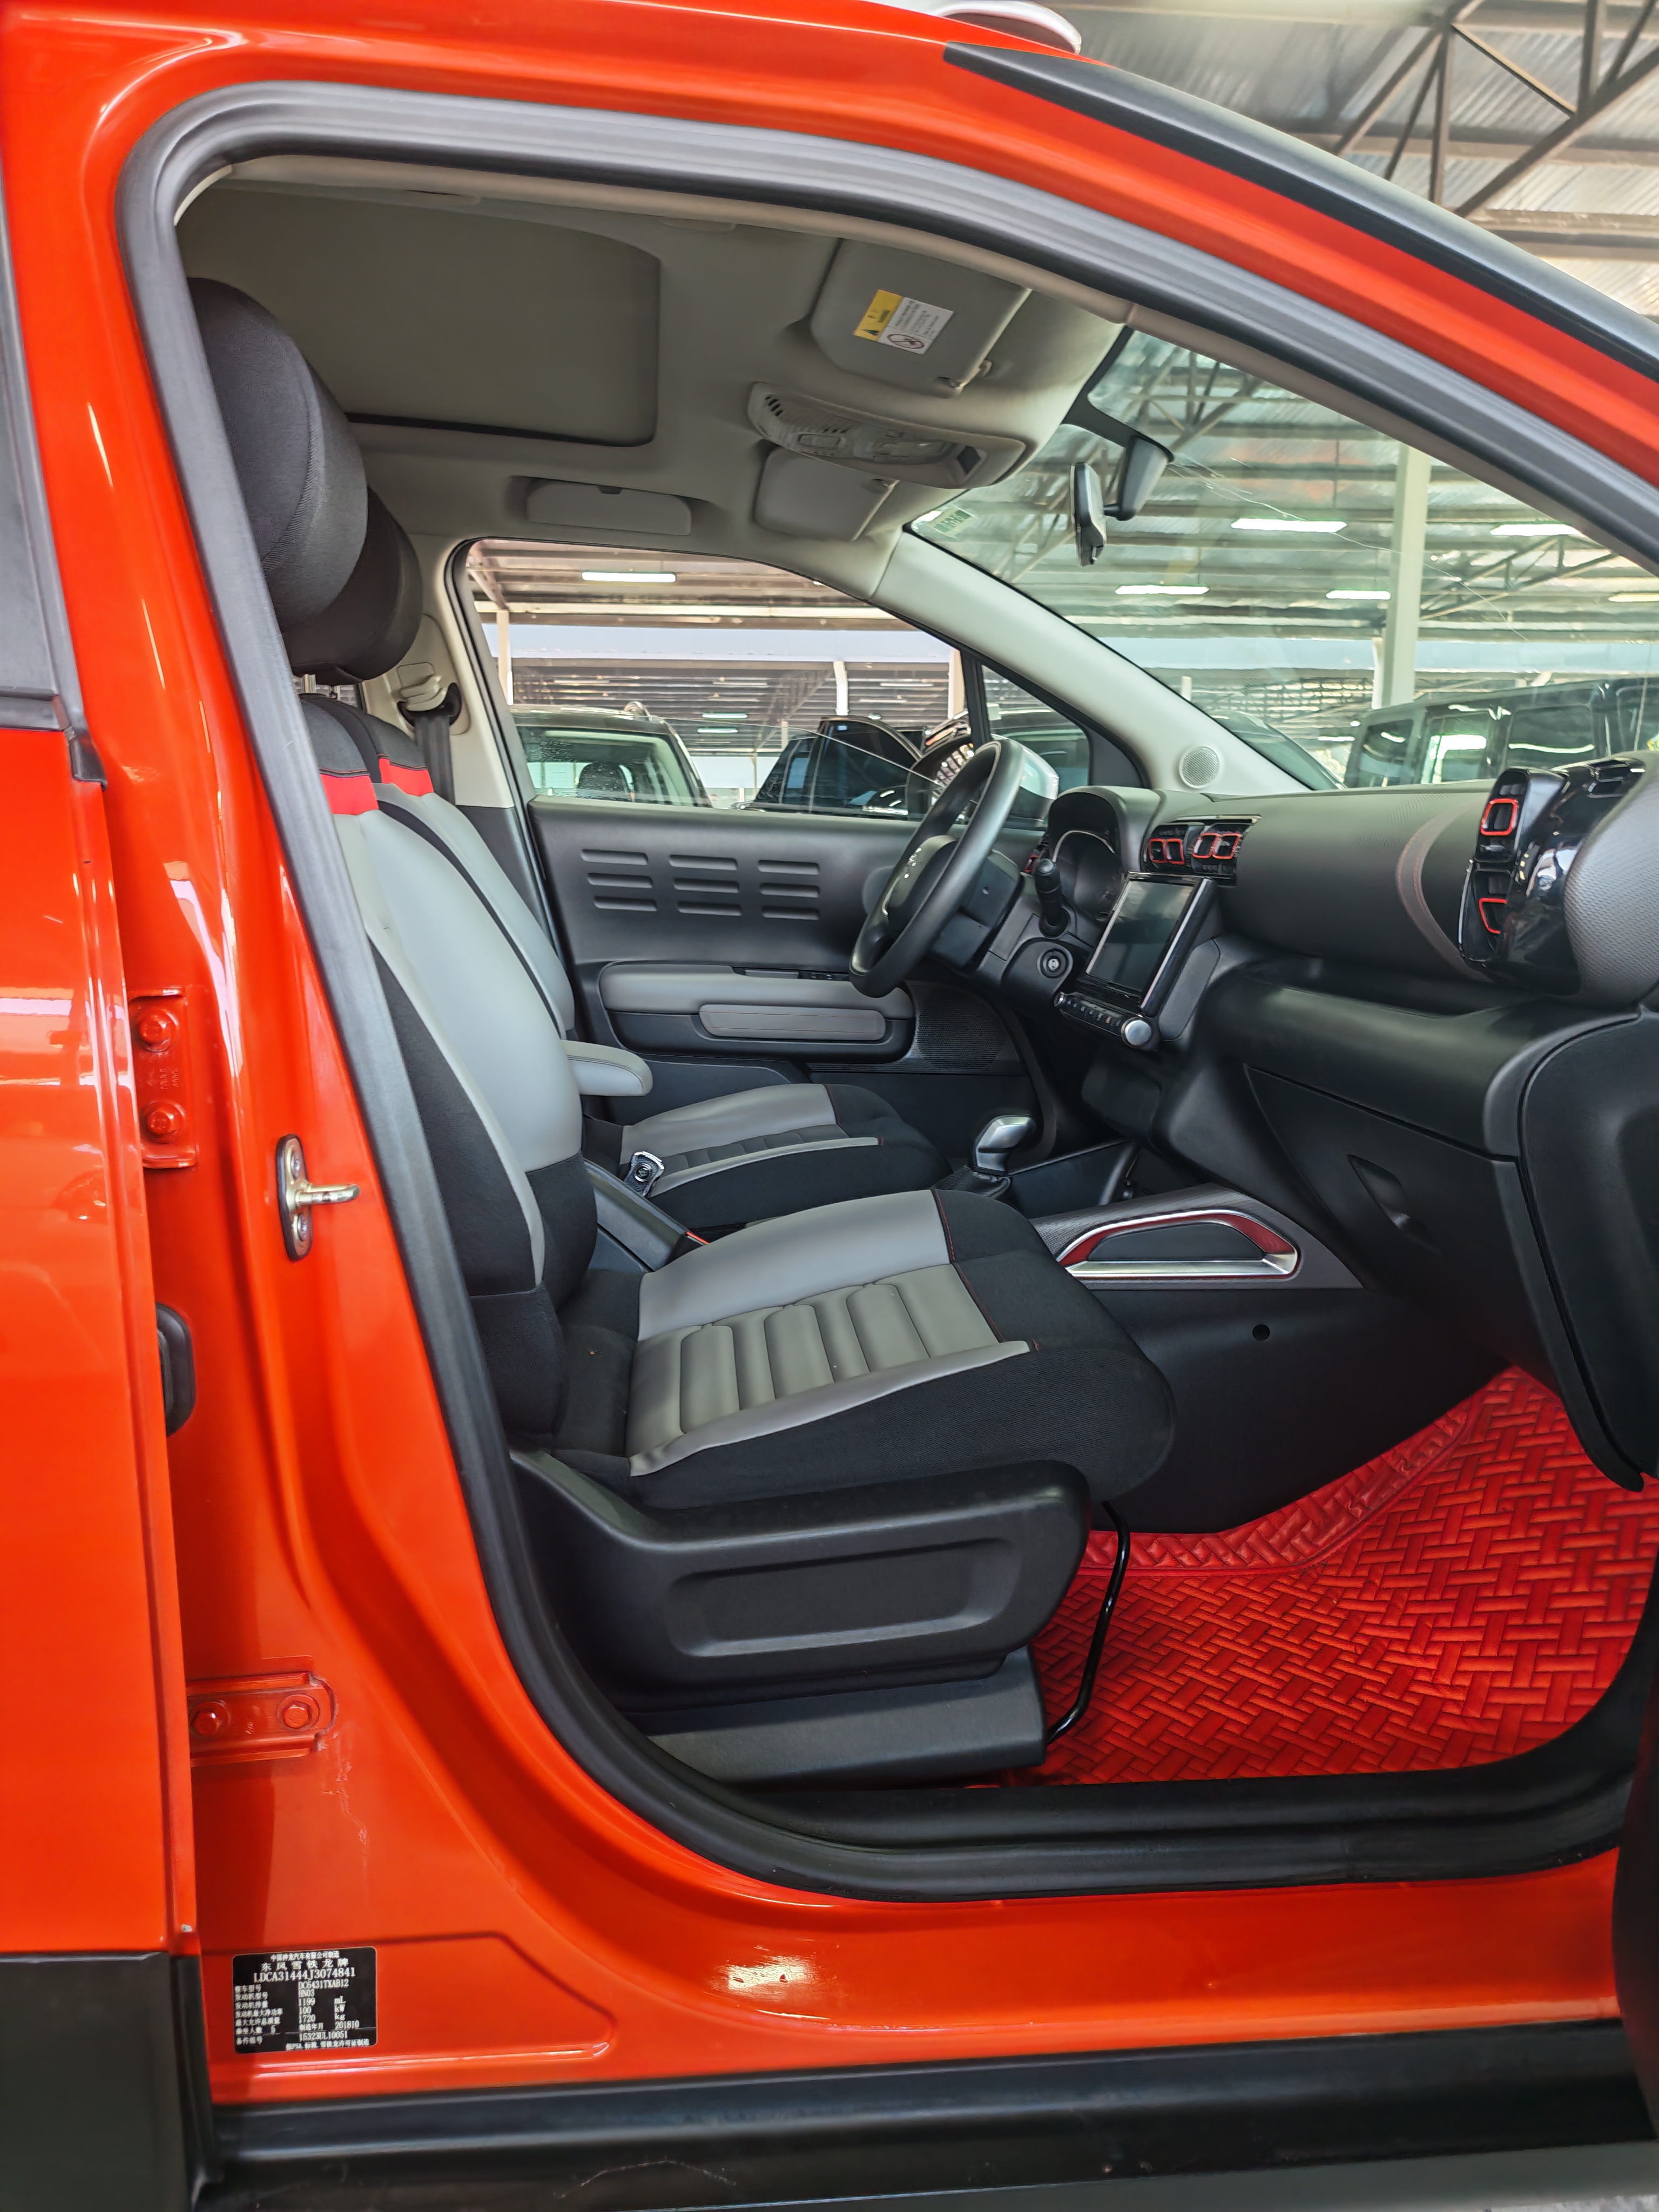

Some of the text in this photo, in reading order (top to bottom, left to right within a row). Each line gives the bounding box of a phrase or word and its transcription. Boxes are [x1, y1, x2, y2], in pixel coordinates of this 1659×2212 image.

[261, 1958, 349, 1972] 东风雪铁龙牌
[254, 1967, 356, 1982] LDCA31444J3074841
[299, 1998, 315, 2007] 1199
[299, 2006, 312, 2015] 100
[334, 2004, 346, 2013] kW
[299, 2014, 315, 2024] 1720
[334, 2013, 346, 2021] kg
[271, 2025, 276, 2034] 5
[335, 2020, 360, 2029] 201810
